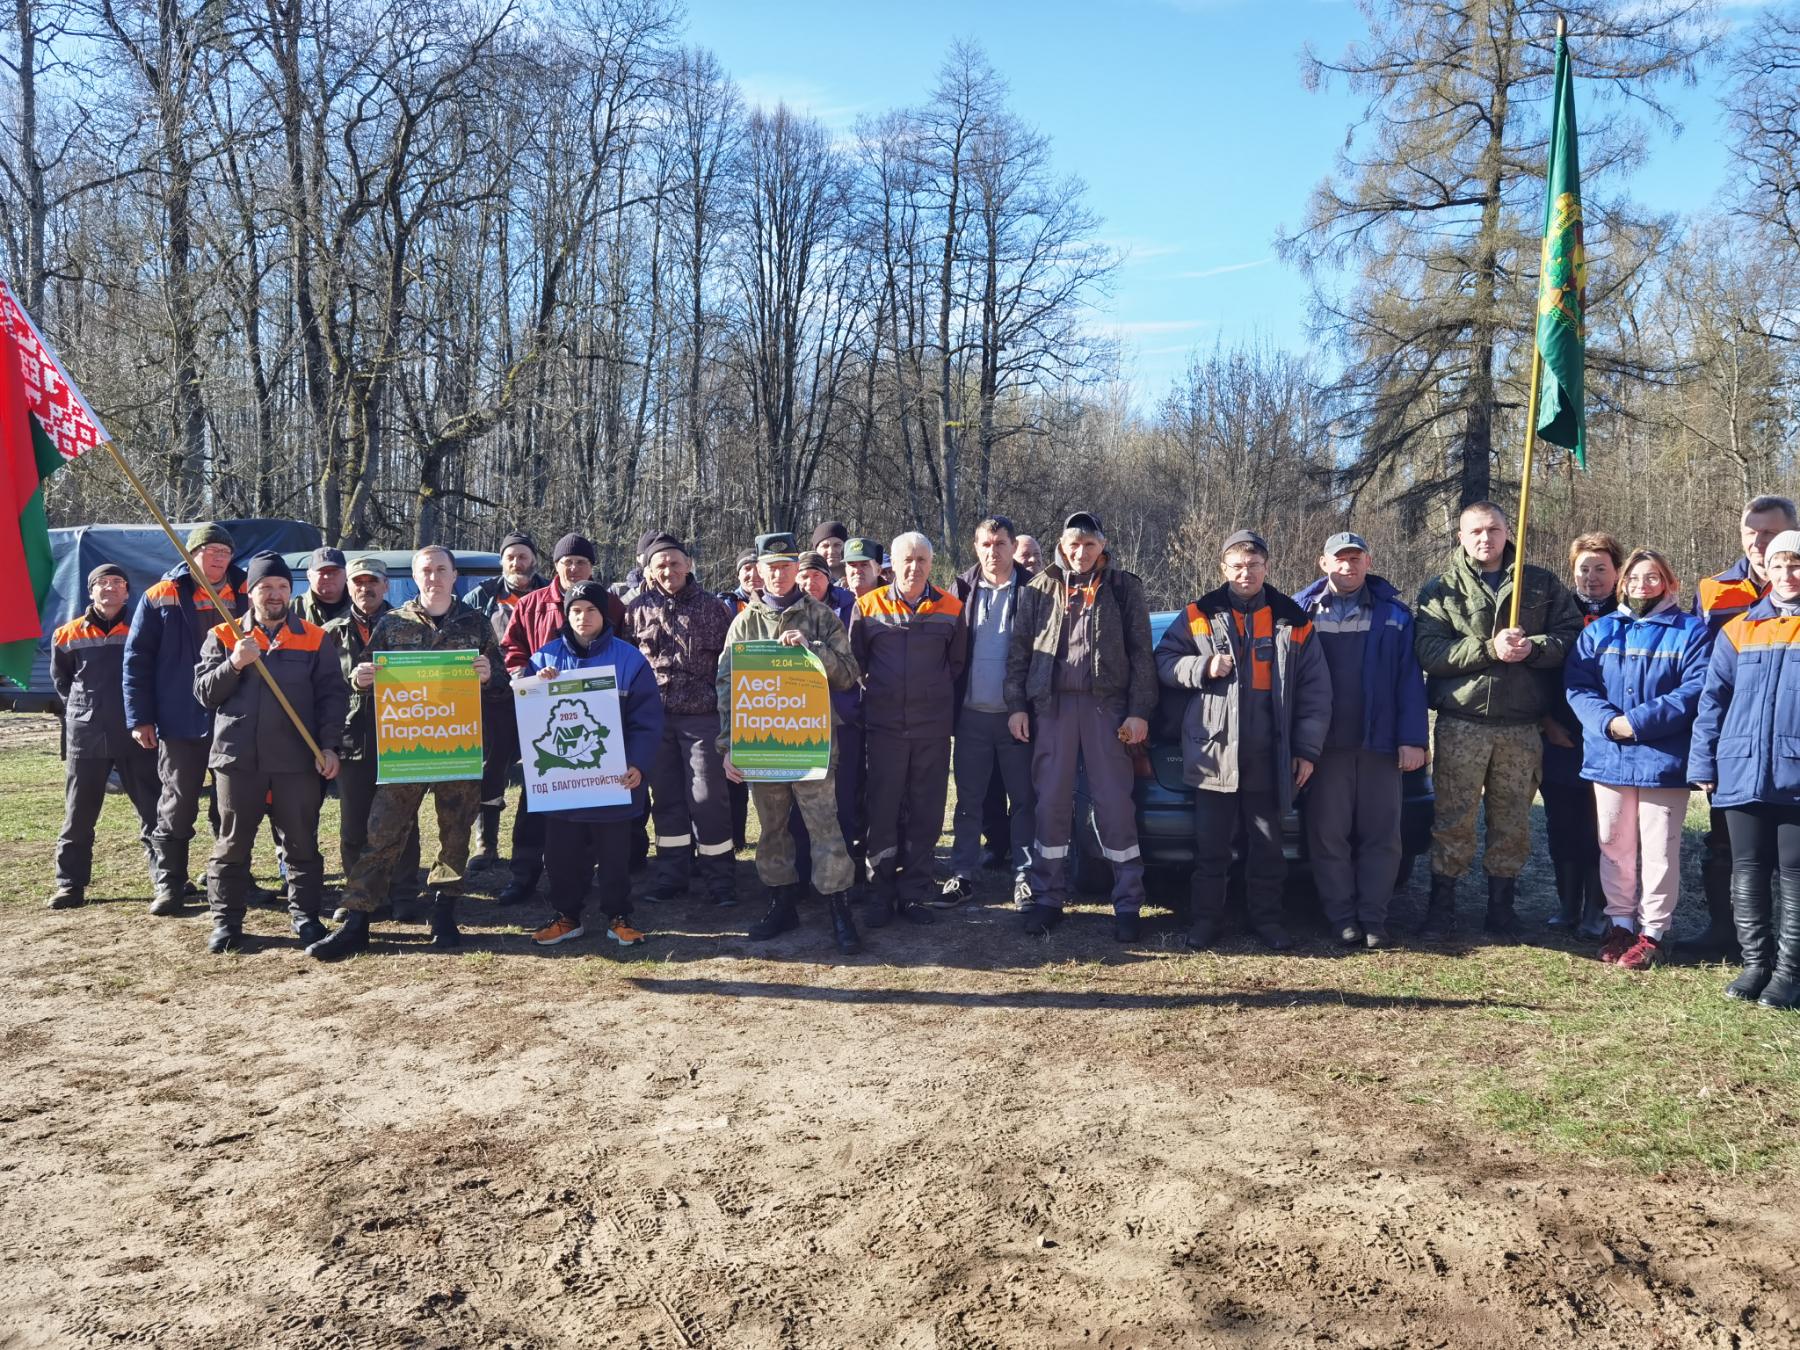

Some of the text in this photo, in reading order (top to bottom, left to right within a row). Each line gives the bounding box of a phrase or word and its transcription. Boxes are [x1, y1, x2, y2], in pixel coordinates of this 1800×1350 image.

[771, 658, 793, 668] 12.04
[416, 669, 439, 678] 12.04
[451, 668, 475, 677] 01.05
[737, 675, 781, 692] Лес!
[381, 685, 428, 703] Лес!
[736, 693, 807, 711] Дабро!
[381, 702, 455, 721] Дабро!
[560, 712, 578, 721] 2025
[381, 720, 478, 740] Парадак!
[735, 712, 827, 731] Парадак!
[532, 783, 549, 794] ГОД
